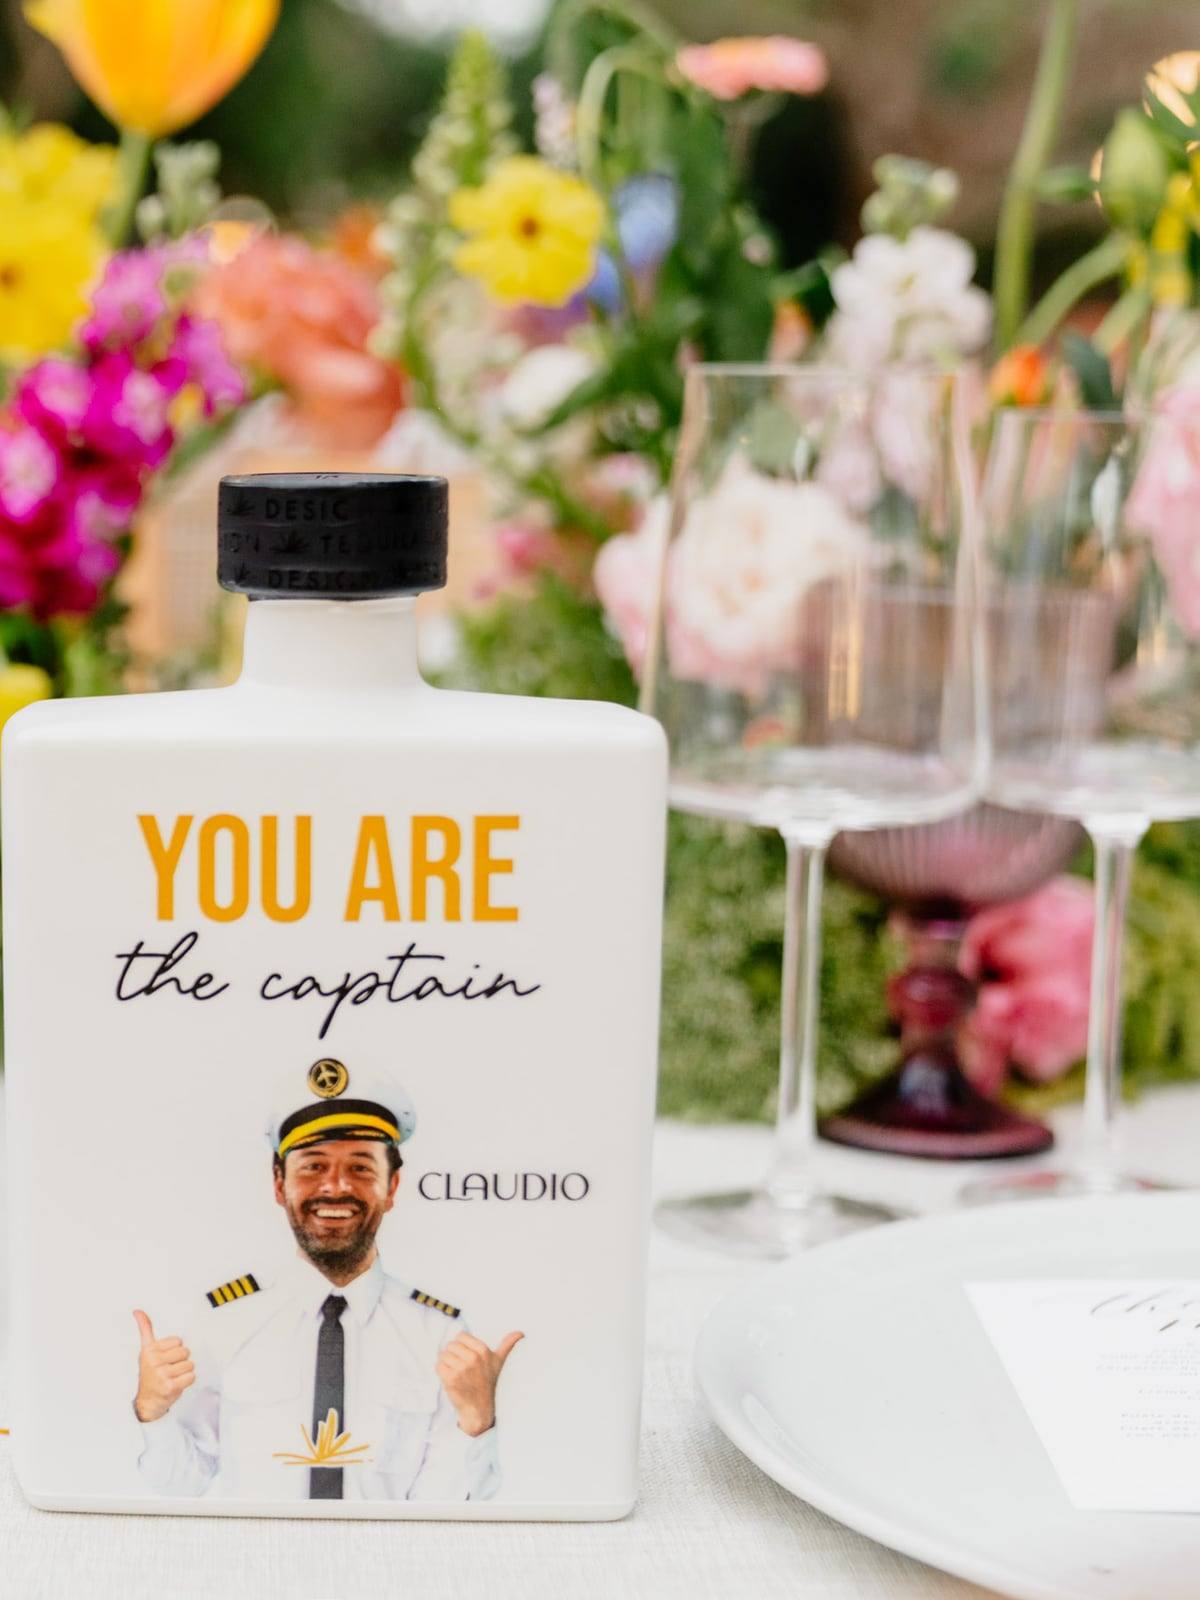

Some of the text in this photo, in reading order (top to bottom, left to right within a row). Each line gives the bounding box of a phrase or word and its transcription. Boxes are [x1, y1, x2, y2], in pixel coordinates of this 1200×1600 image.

[136, 813, 521, 923] YOU ARE
[114, 931, 542, 1041] the captain
[417, 1171, 590, 1202] CLAUDIO
